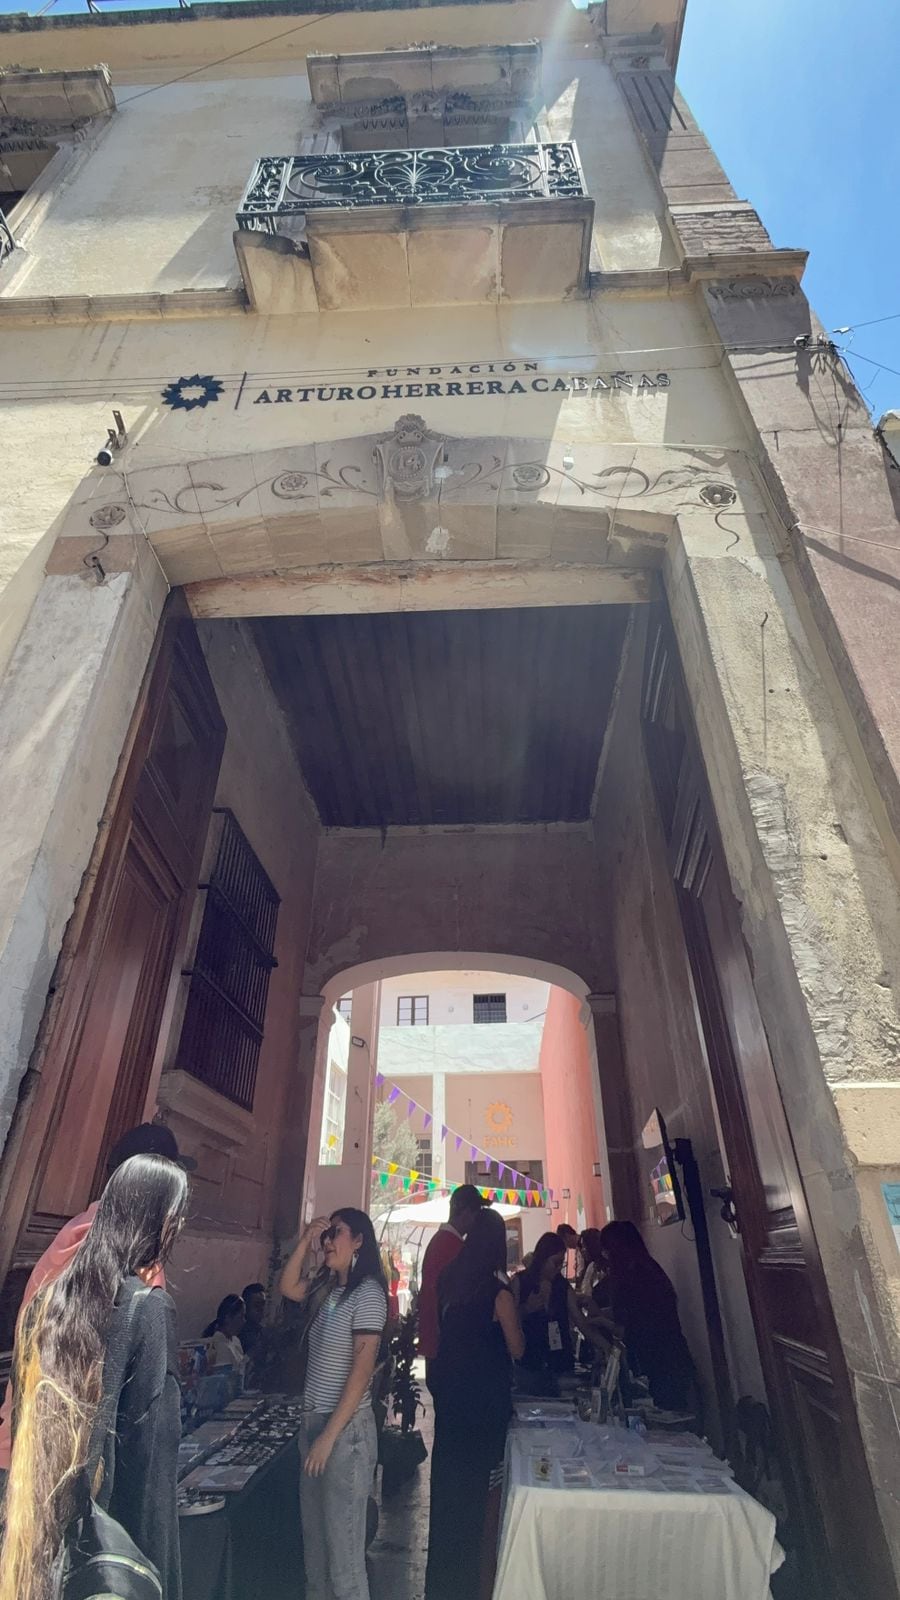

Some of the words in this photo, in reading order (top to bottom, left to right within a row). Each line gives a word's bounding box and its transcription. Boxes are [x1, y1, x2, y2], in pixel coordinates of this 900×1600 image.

[367, 361, 538, 378] FUNDACIÓN
[253, 386, 377, 404] ARTURO
[381, 380, 527, 399] HERRERA
[532, 371, 671, 393] CABAÑAS
